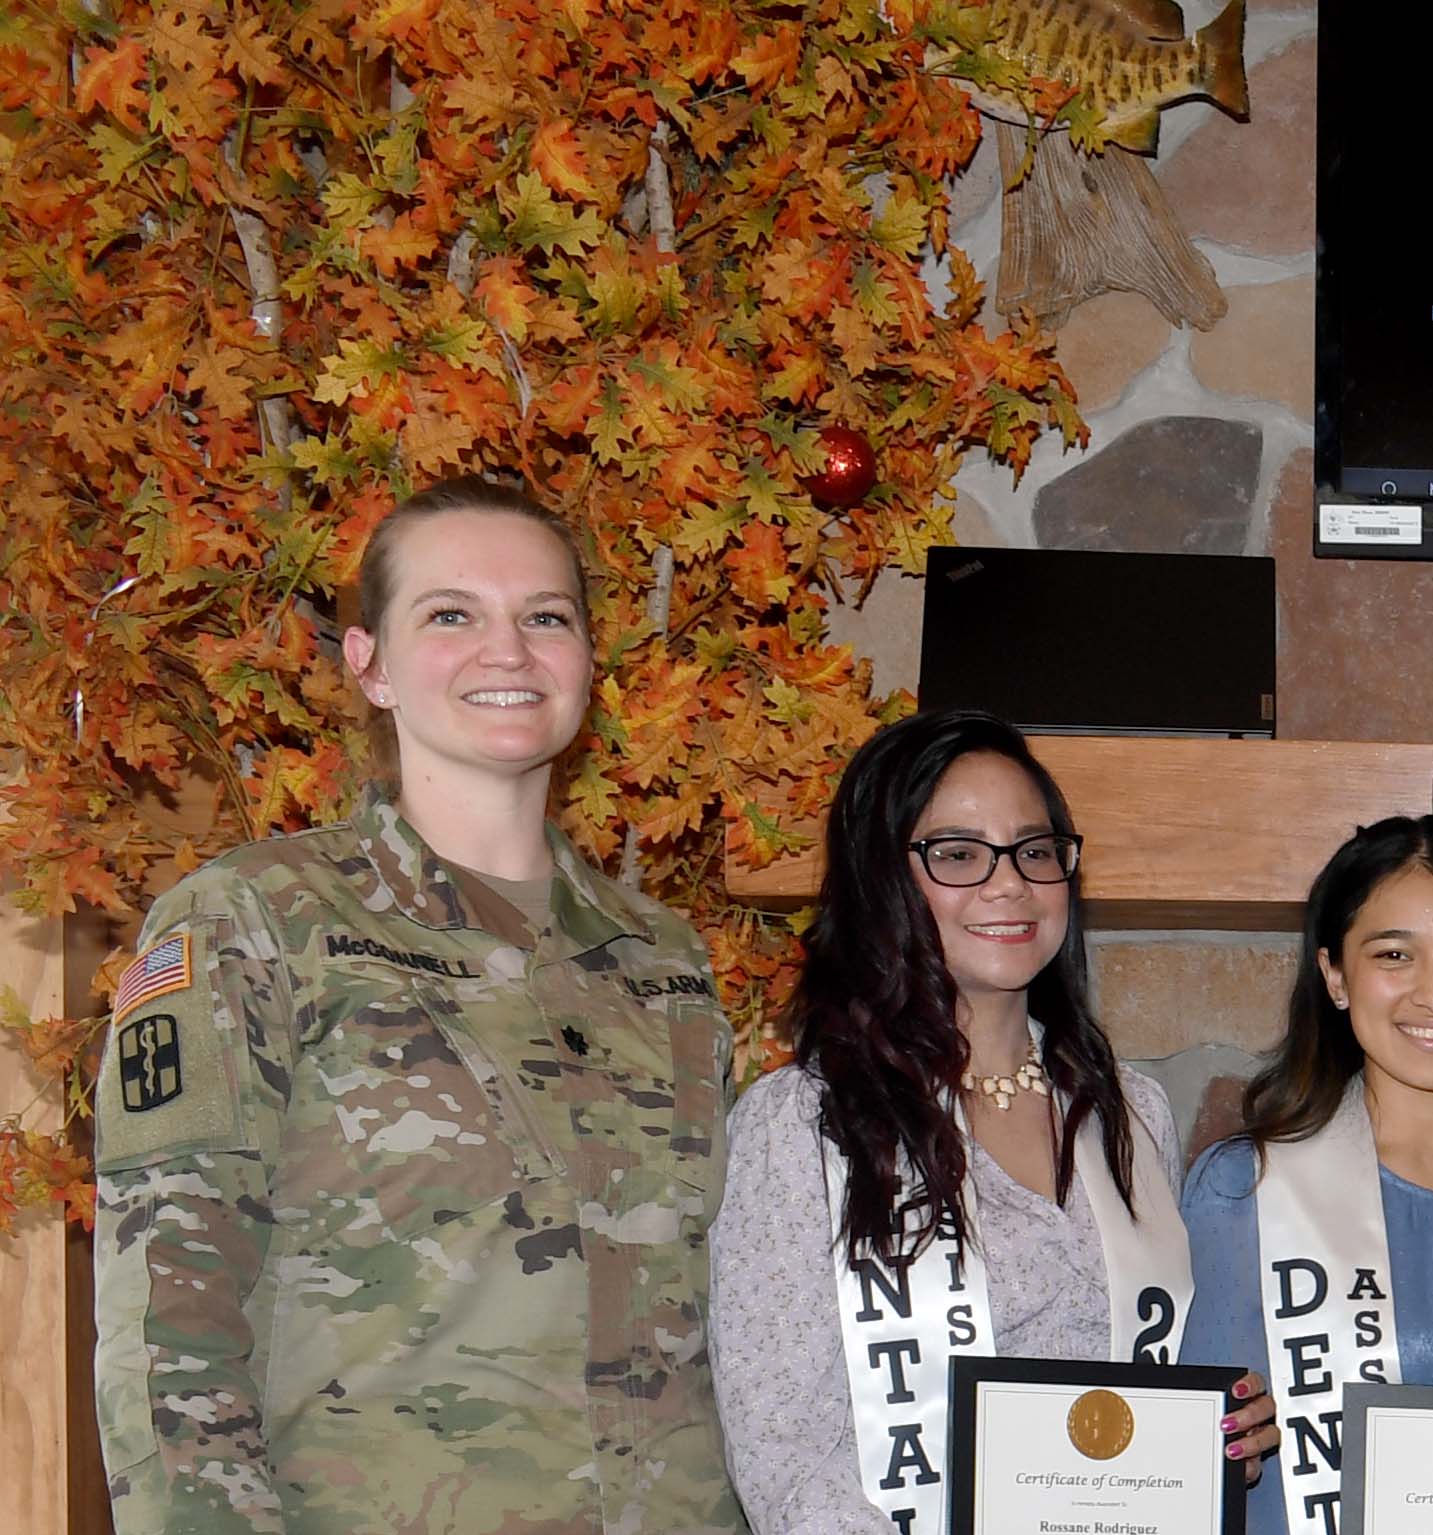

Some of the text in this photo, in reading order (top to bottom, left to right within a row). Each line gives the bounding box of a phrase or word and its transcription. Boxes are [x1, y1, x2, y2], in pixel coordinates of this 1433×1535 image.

[1015, 1472, 1184, 1491] Certificate of Completion
[1039, 1520, 1091, 1533] Rossane
